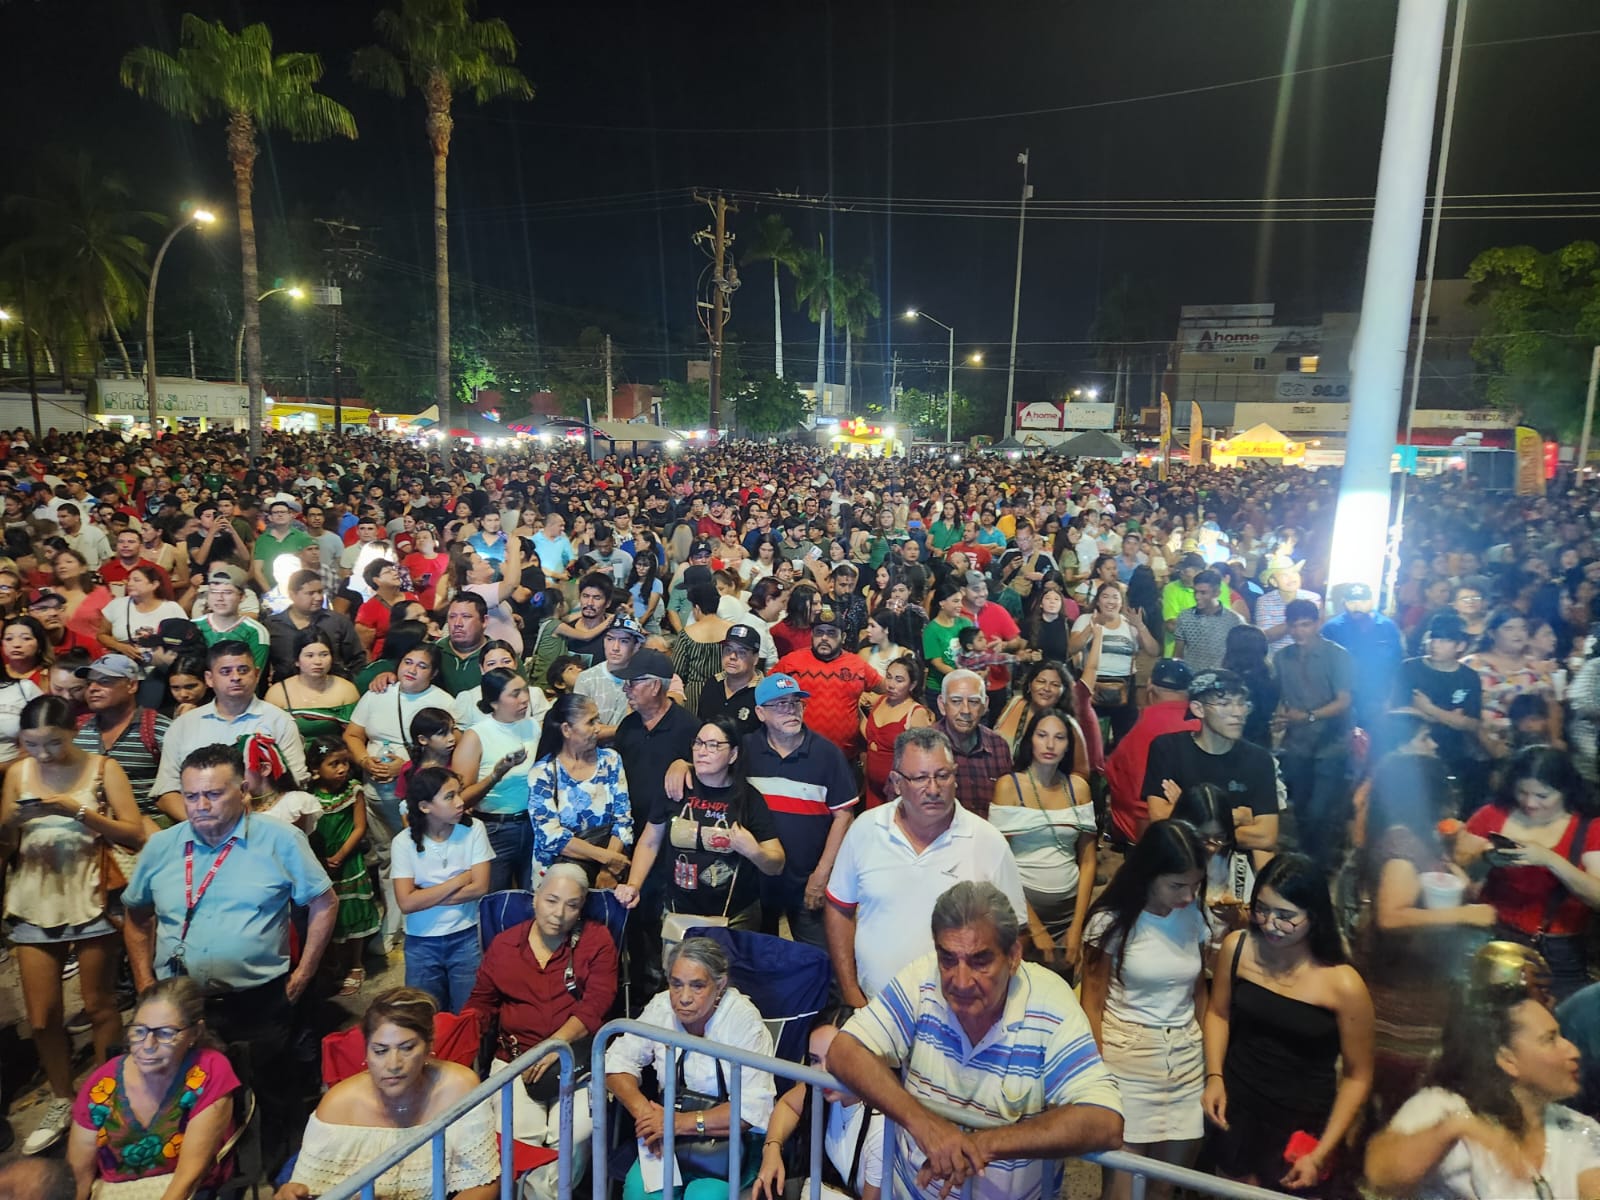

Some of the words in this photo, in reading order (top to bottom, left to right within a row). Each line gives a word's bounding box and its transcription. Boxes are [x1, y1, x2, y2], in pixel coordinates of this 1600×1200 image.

[1197, 331, 1259, 349] Ahome
[1024, 411, 1058, 421] Ahome
[688, 796, 728, 811] TRENDY
